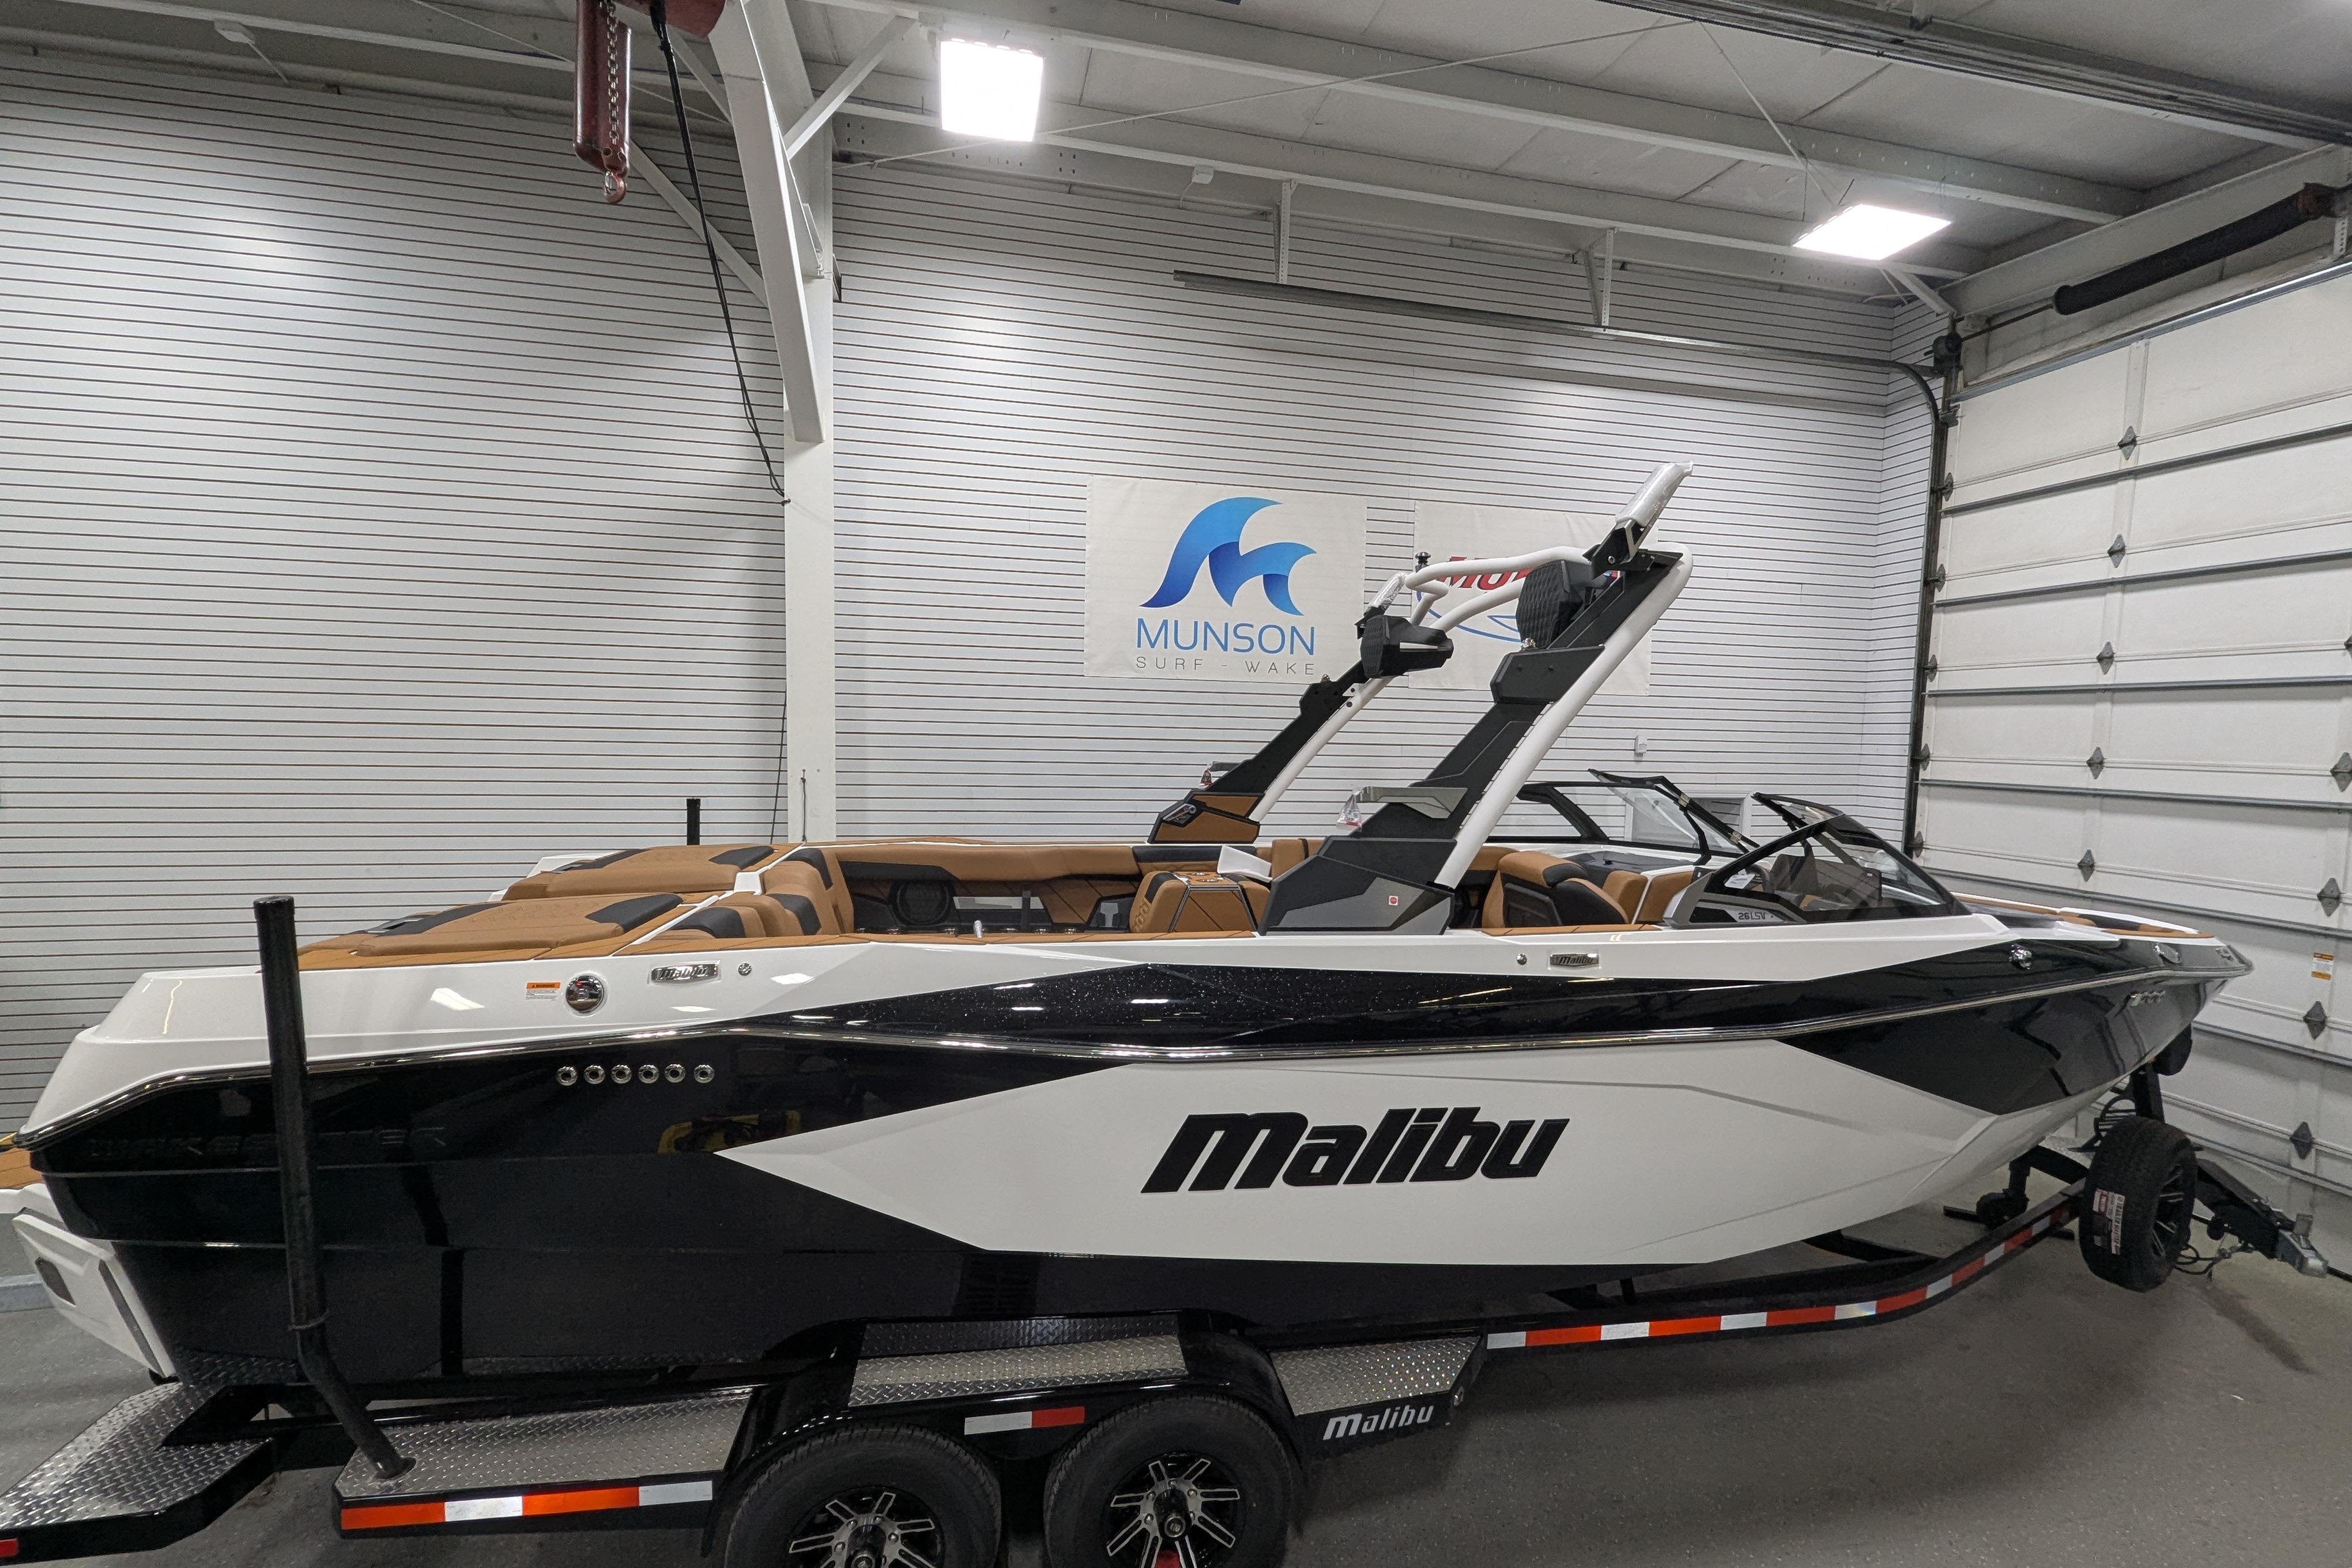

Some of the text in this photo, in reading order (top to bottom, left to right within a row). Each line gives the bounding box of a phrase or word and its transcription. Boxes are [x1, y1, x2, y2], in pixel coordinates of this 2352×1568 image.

[1136, 618, 1315, 656] MUNSON
[1136, 656, 1204, 670] SURF
[1244, 661, 1315, 675] WAKE
